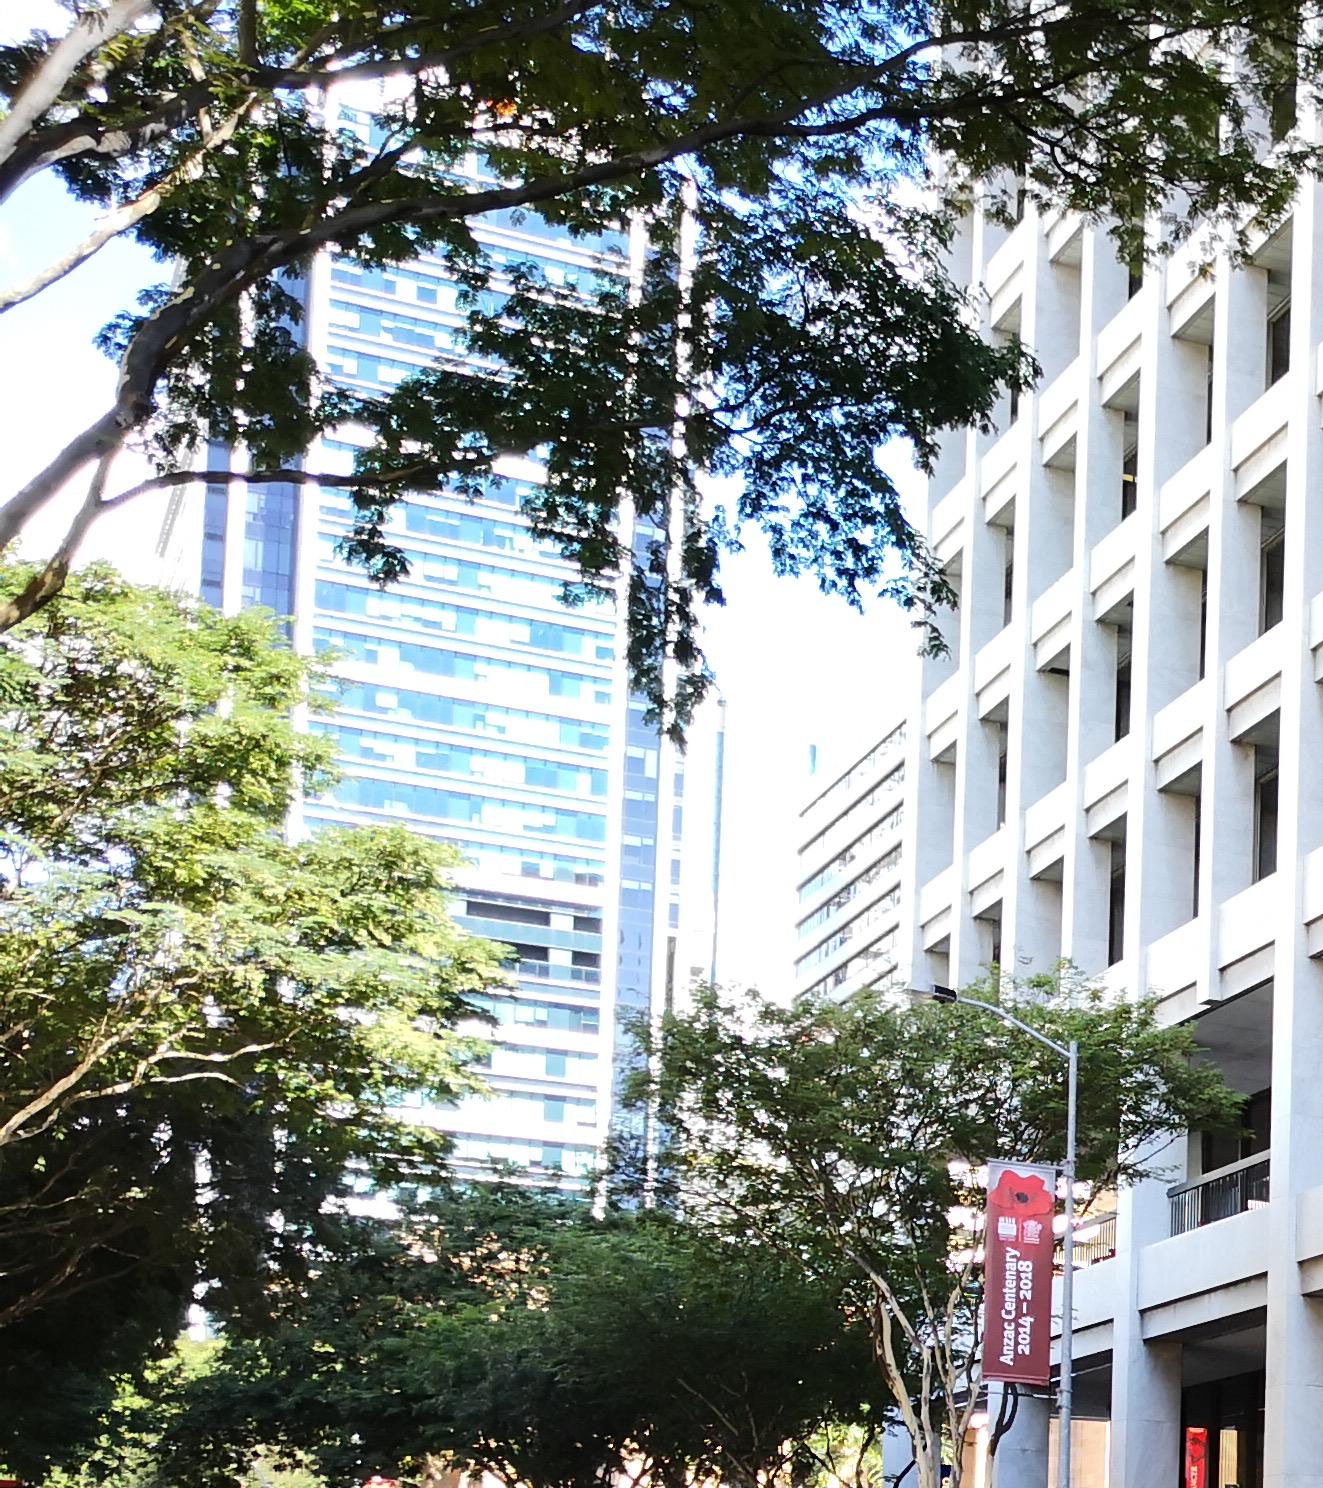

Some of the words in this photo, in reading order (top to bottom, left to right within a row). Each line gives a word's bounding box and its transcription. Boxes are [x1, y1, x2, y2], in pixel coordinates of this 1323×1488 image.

[1001, 1246, 1021, 1320] Centenary
[1017, 1260, 1034, 1301] 2018
[999, 1321, 1016, 1366] Anzac
[1017, 1316, 1035, 1356] 2014
